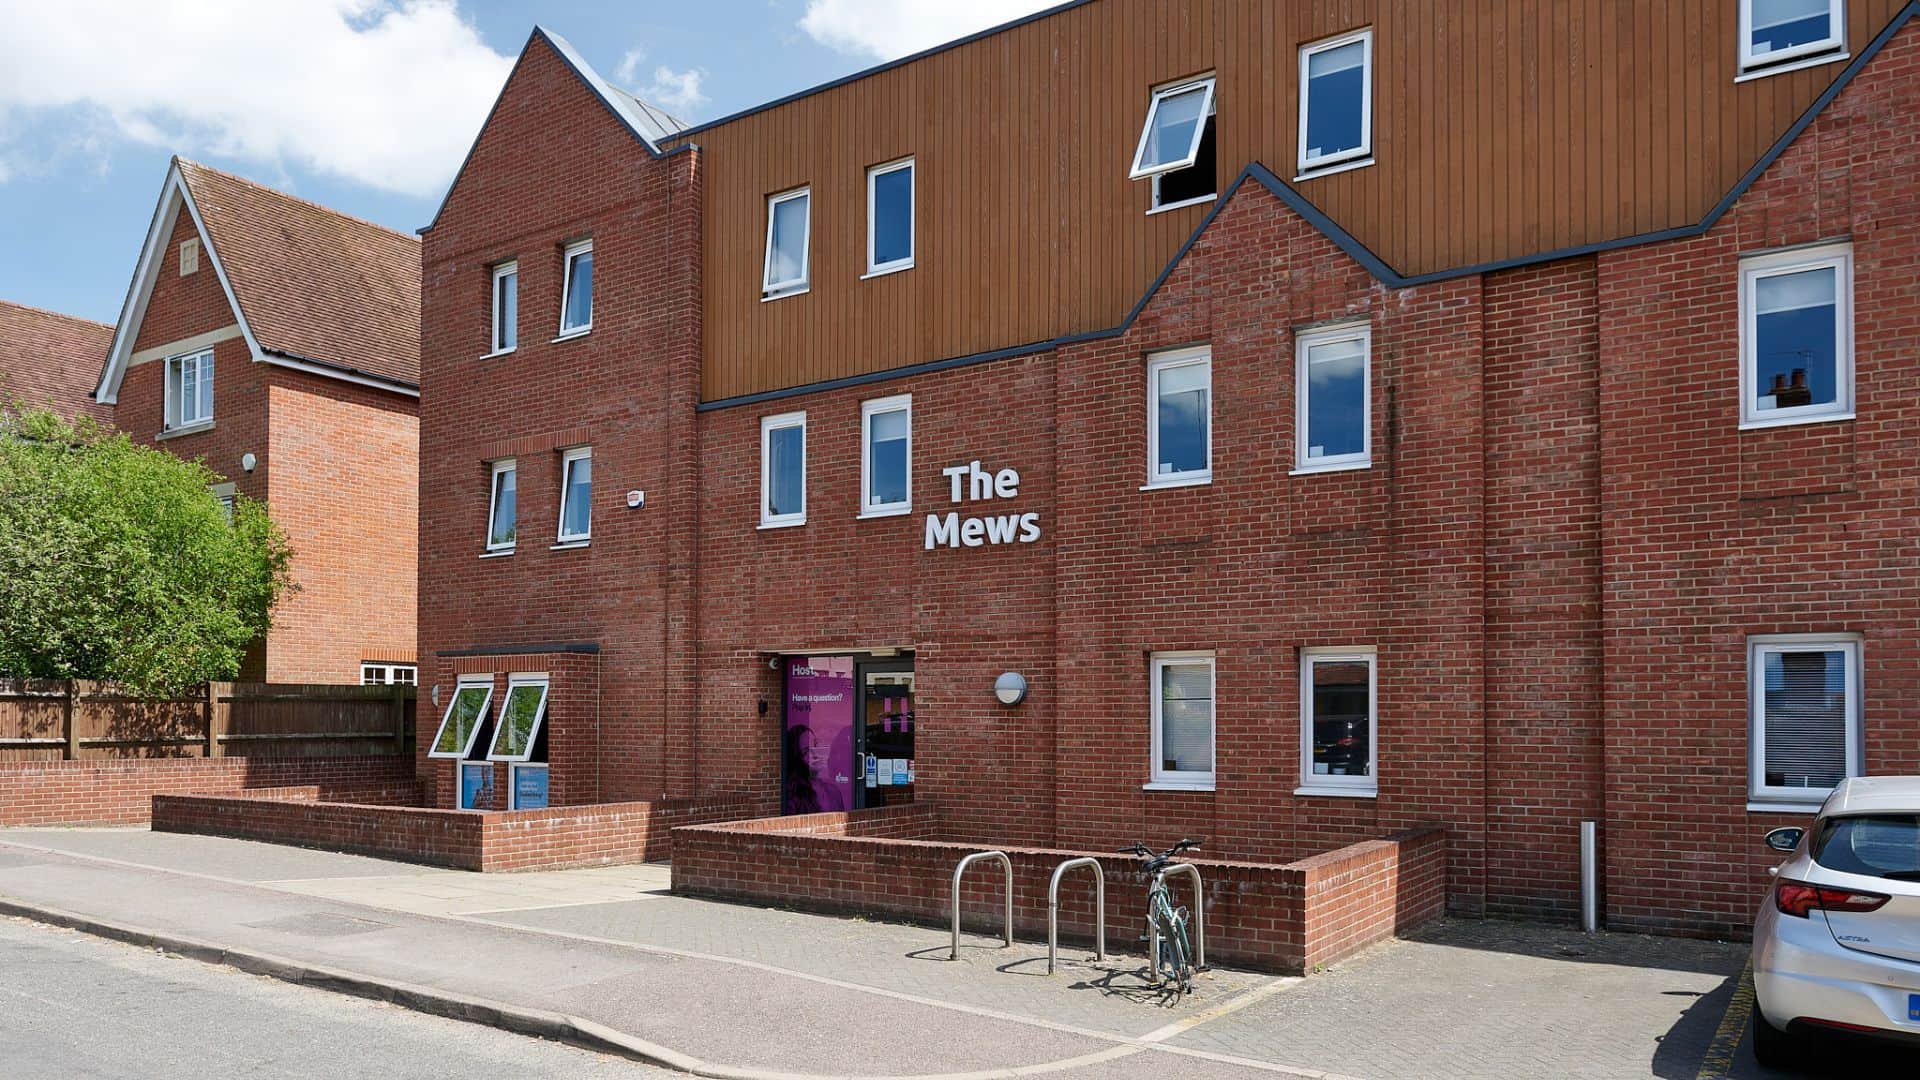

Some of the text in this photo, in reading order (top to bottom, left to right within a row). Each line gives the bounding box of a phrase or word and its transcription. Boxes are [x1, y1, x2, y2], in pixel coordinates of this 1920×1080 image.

[943, 460, 1019, 502] The
[925, 512, 1041, 550] Mews
[792, 693, 808, 702] Have
[814, 692, 843, 703] question?
[1837, 935, 1870, 943] ASTRA
